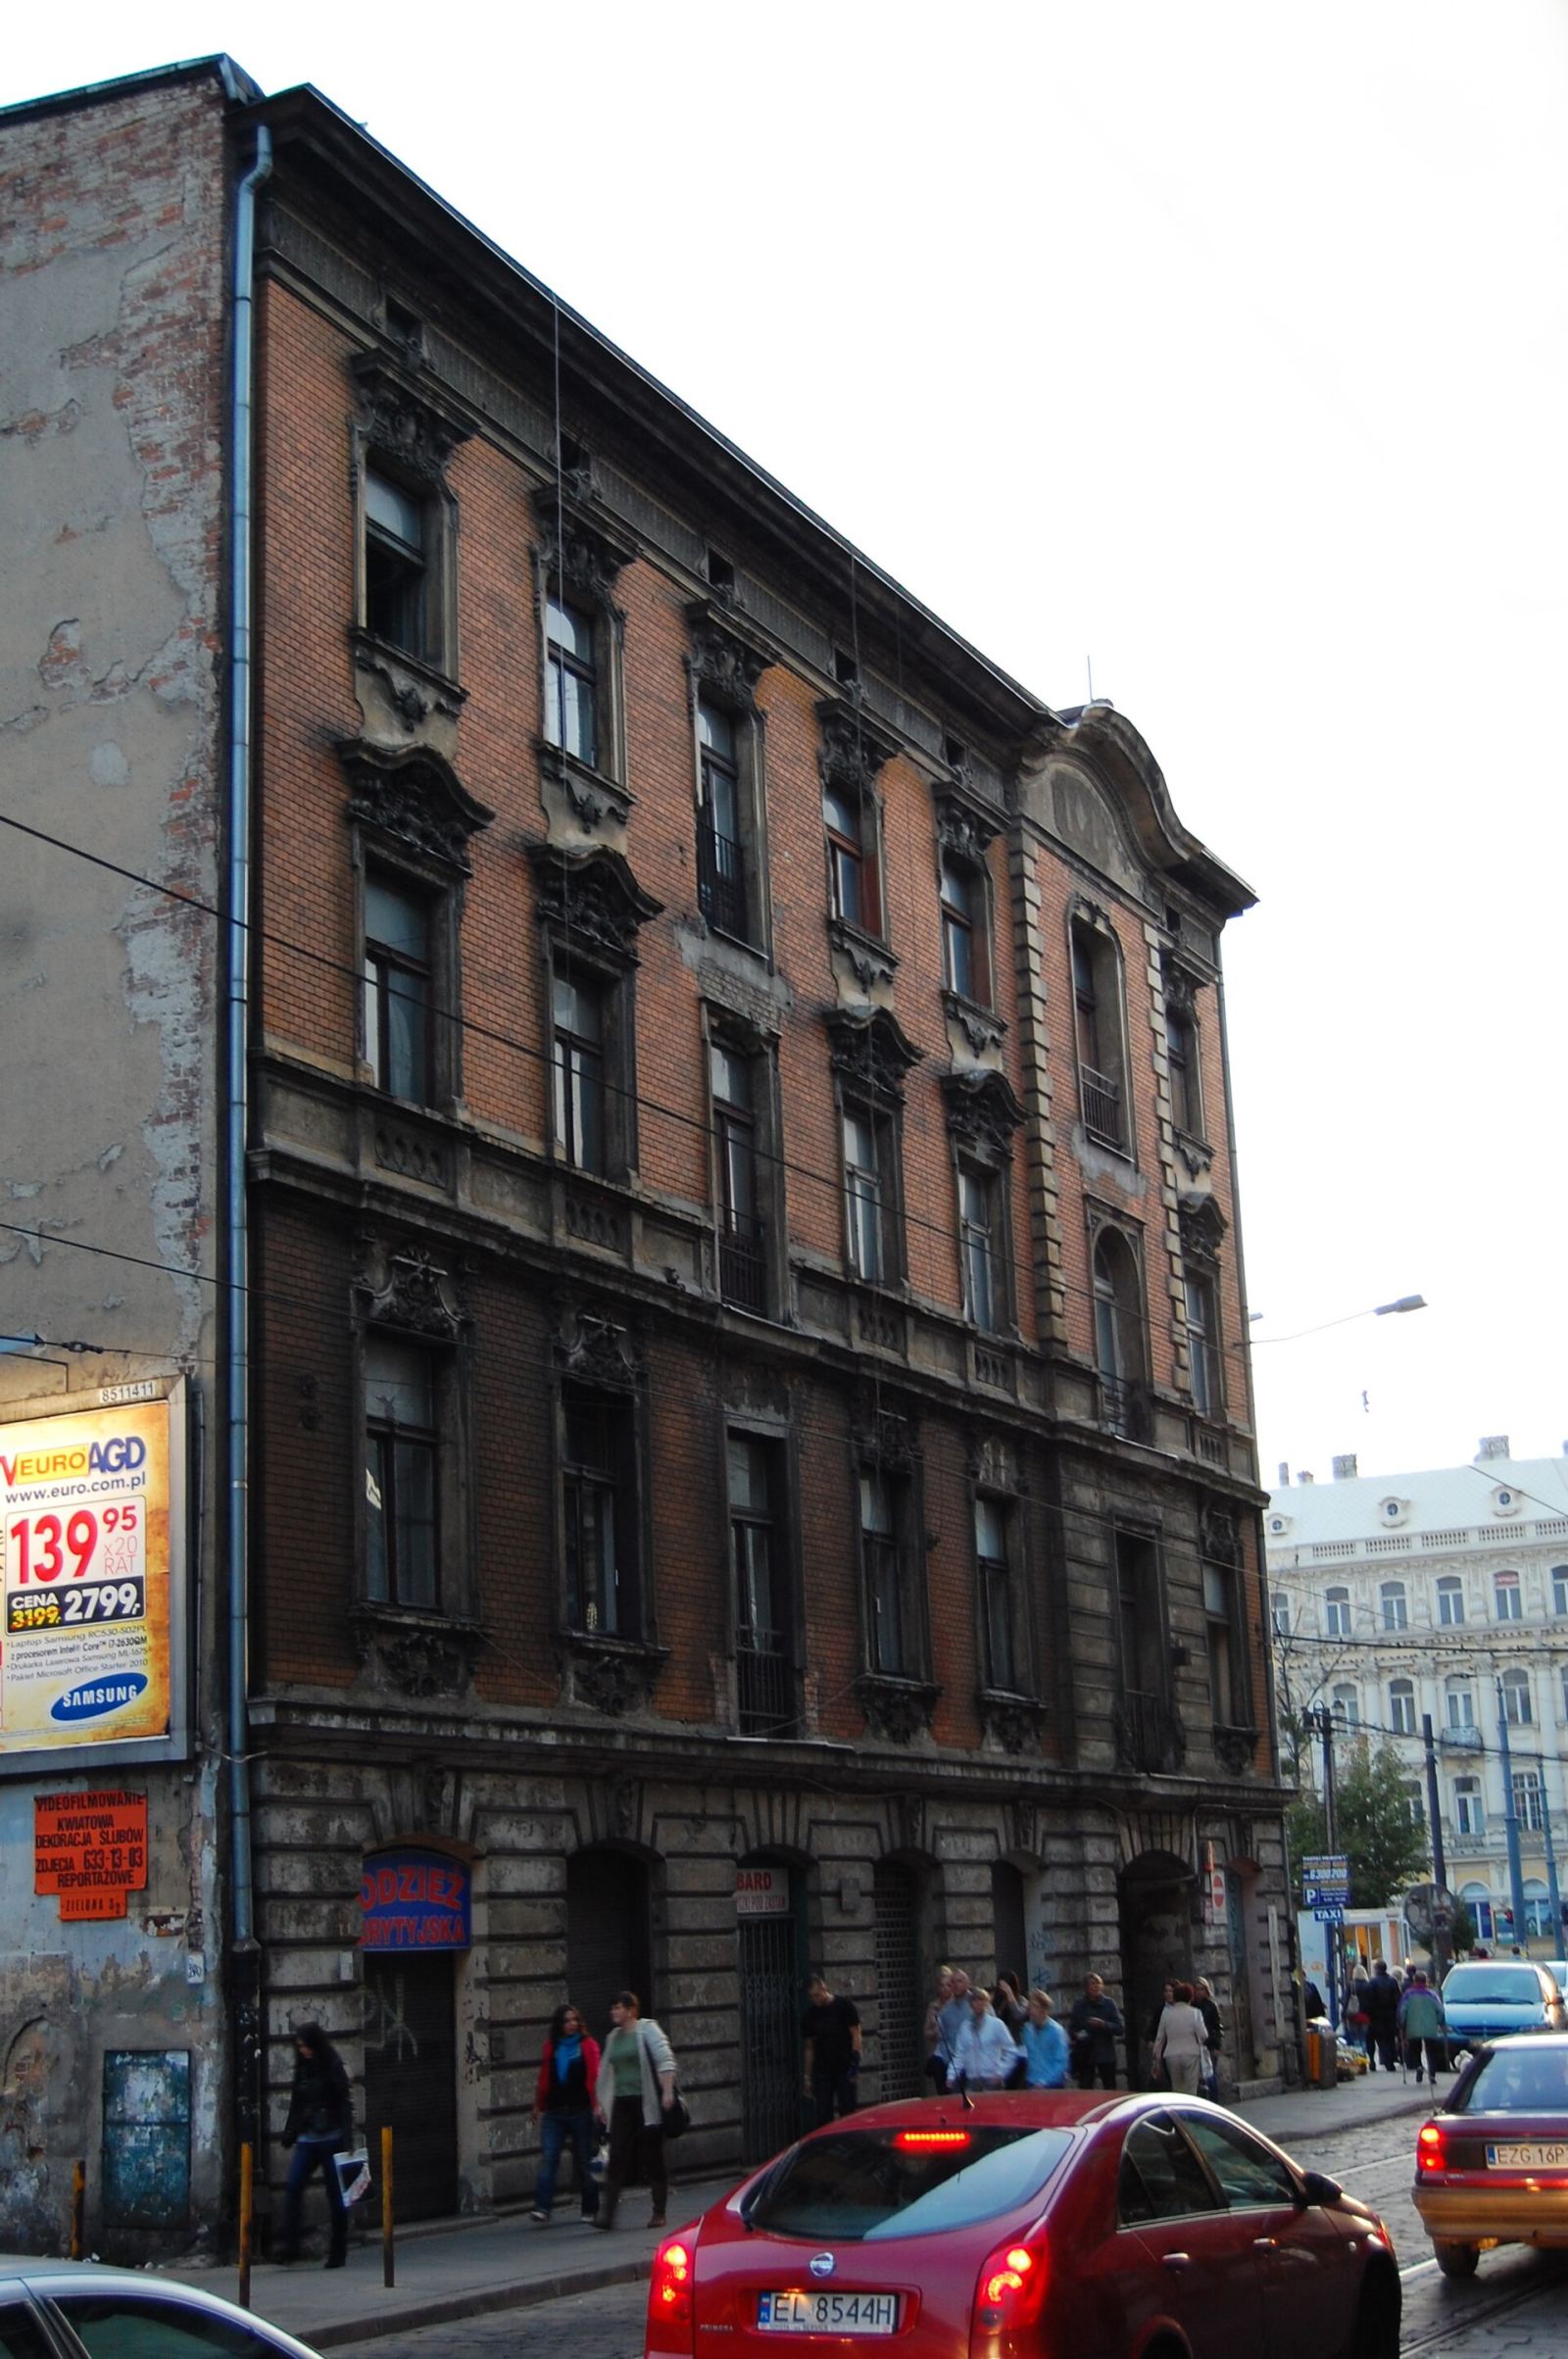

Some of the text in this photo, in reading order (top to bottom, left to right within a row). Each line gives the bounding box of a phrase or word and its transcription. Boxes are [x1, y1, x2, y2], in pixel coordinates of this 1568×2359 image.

[102, 1383, 154, 1401] 8511411
[21, 1452, 86, 1477] EURO
[88, 1436, 146, 1474] AGD
[5, 1472, 146, 1504] www.euro.com.pl
[10, 1509, 98, 1585] 139
[102, 1504, 138, 1533] 95
[104, 1554, 137, 1576] RAT
[11, 1592, 59, 1609] CENA
[11, 1639, 42, 1648] Laptop
[44, 1633, 86, 1645] Samsung
[16, 1648, 59, 1661] procesorem
[82, 1651, 117, 1662] Samsung
[36, 1667, 73, 1679] Microsoft
[74, 1664, 99, 1674] Office
[100, 1662, 126, 1671] Starter
[63, 1685, 139, 1708] SAMSUNG
[35, 1791, 144, 1812] VIDEOFILMOWANIE
[57, 1814, 115, 1832] KWIATOWA
[35, 1826, 144, 1849] DEKORACJA ŚLUBÓW
[1306, 1889, 1316, 1903] P
[1315, 1909, 1342, 1920] TAXI
[1497, 2146, 1568, 2164] EZG 16P
[774, 2296, 892, 2326] EL 8544H
